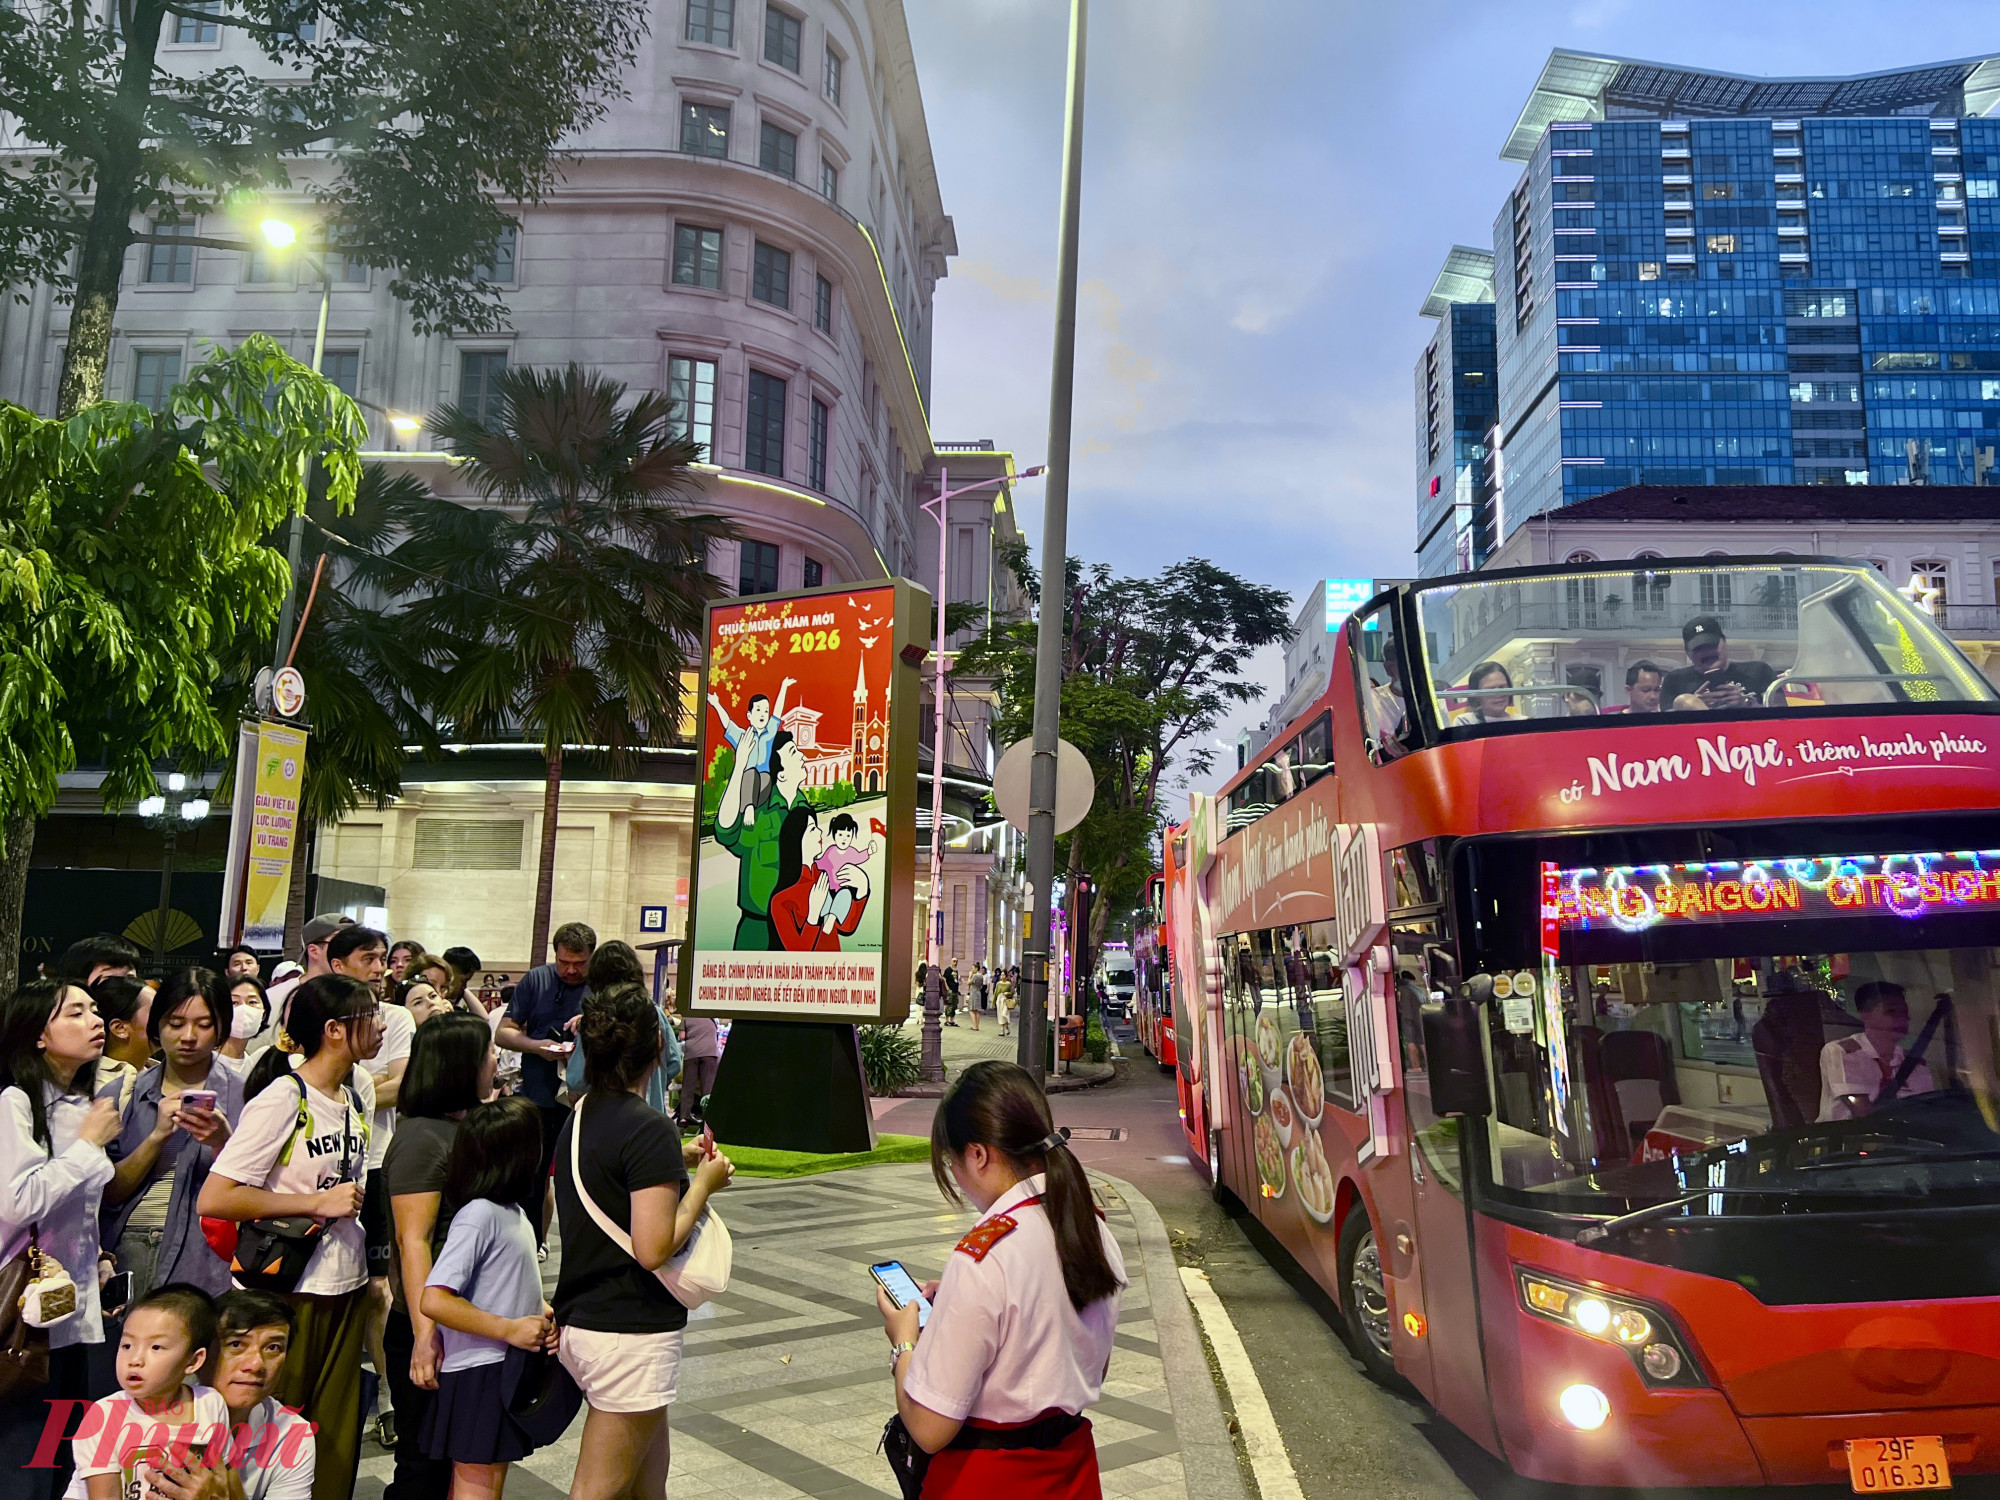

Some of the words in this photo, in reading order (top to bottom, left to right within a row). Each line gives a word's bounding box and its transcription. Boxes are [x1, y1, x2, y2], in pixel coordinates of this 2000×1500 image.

[718, 620, 745, 636] CHÚC
[748, 617, 781, 633] MỪNG
[811, 612, 835, 626] MỚI
[789, 629, 841, 654] 2026
[1559, 778, 1586, 805] có
[1586, 751, 1691, 796] Nam
[1696, 735, 1793, 786] Ngư,
[1796, 741, 1860, 765] thêm
[1860, 733, 1928, 761] hạnh
[1928, 731, 1988, 760] phúc
[272, 796, 286, 811] VIỆT
[268, 835, 288, 848] TRANG
[1221, 854, 1241, 923] Nam
[1284, 810, 1305, 877] hạnh
[1306, 801, 1329, 878] phúc
[1654, 878, 1800, 914] SAIGON
[1826, 873, 1910, 906] CITY
[702, 960, 718, 979] ĐẢNG
[728, 962, 745, 979] CHÍNH
[746, 960, 765, 980] QUYỀN
[765, 962, 773, 979] VÀ
[774, 962, 790, 980] NHÂN
[791, 962, 803, 980] DÂN
[804, 962, 824, 981] THÀNH
[824, 961, 837, 981] PHỐ
[837, 961, 846, 981] HỒ
[846, 963, 858, 981] CHÍ
[858, 966, 875, 982] MINH
[698, 985, 718, 1000] CHUNG
[718, 986, 727, 1001] TAY
[734, 983, 751, 1001] NGƯỜI
[782, 983, 793, 1002] TẾT
[793, 983, 806, 1003] ĐẾN
[806, 985, 816, 1003] VỚI
[816, 988, 829, 1007] MỌI
[850, 989, 863, 1008] MỌI
[863, 985, 877, 1005] NHÀ
[306, 1133, 342, 1158] NEW
[1875, 1439, 1915, 1462] 29F
[1862, 1463, 1939, 1488] 016.33
